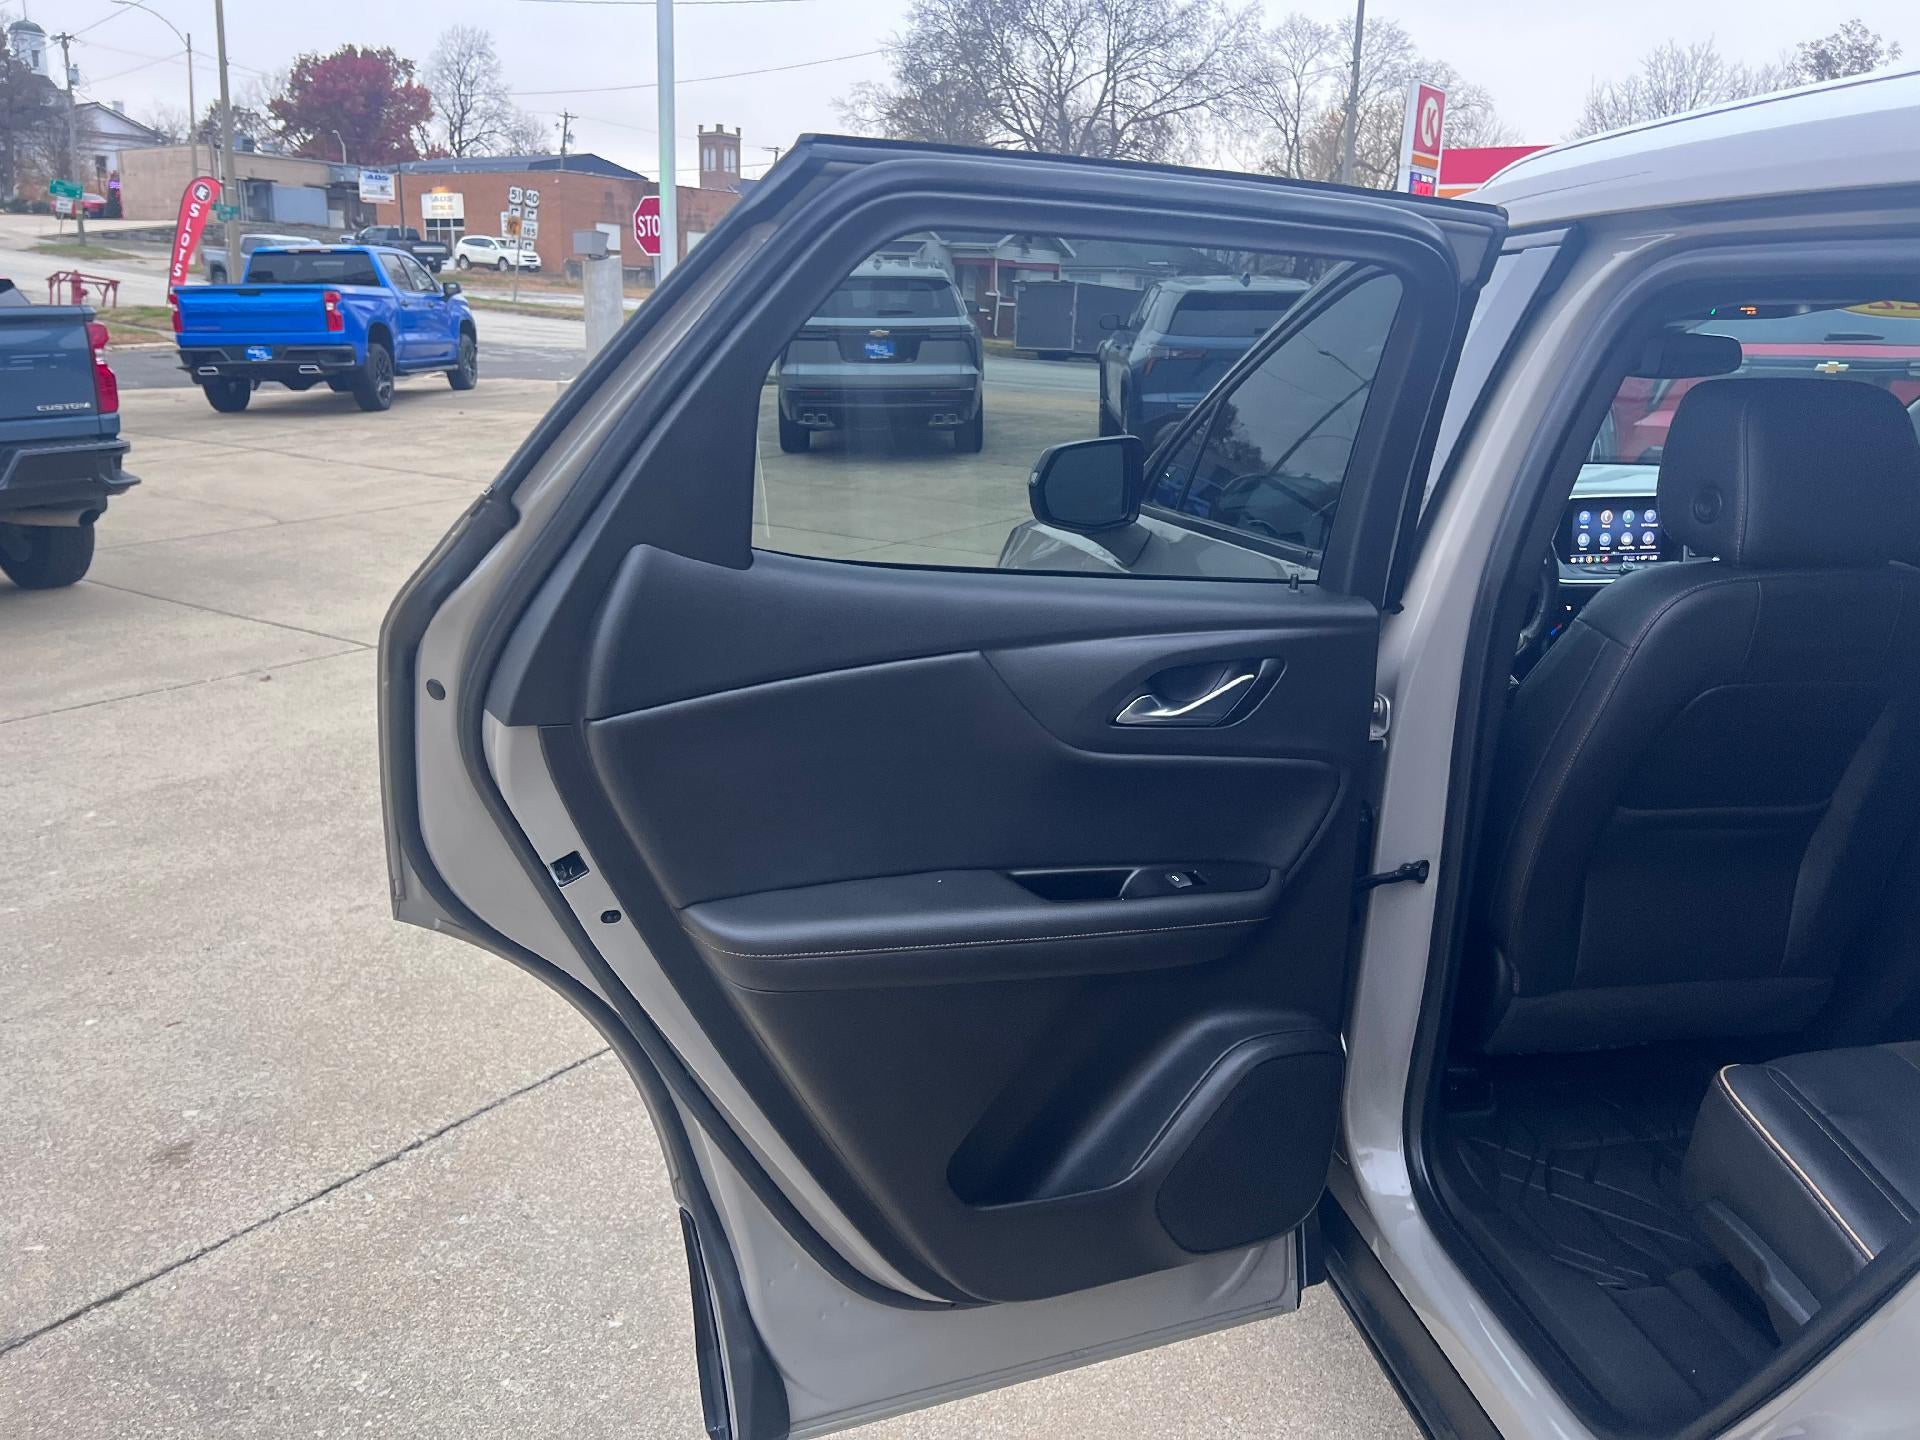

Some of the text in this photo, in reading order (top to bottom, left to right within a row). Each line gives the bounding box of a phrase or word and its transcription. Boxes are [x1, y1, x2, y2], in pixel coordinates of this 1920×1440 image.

[511, 189, 521, 200] 51
[527, 193, 539, 204] 40
[637, 215, 660, 237] STO
[173, 203, 200, 277] SLOTS
[36, 402, 91, 411] CUSTOM
